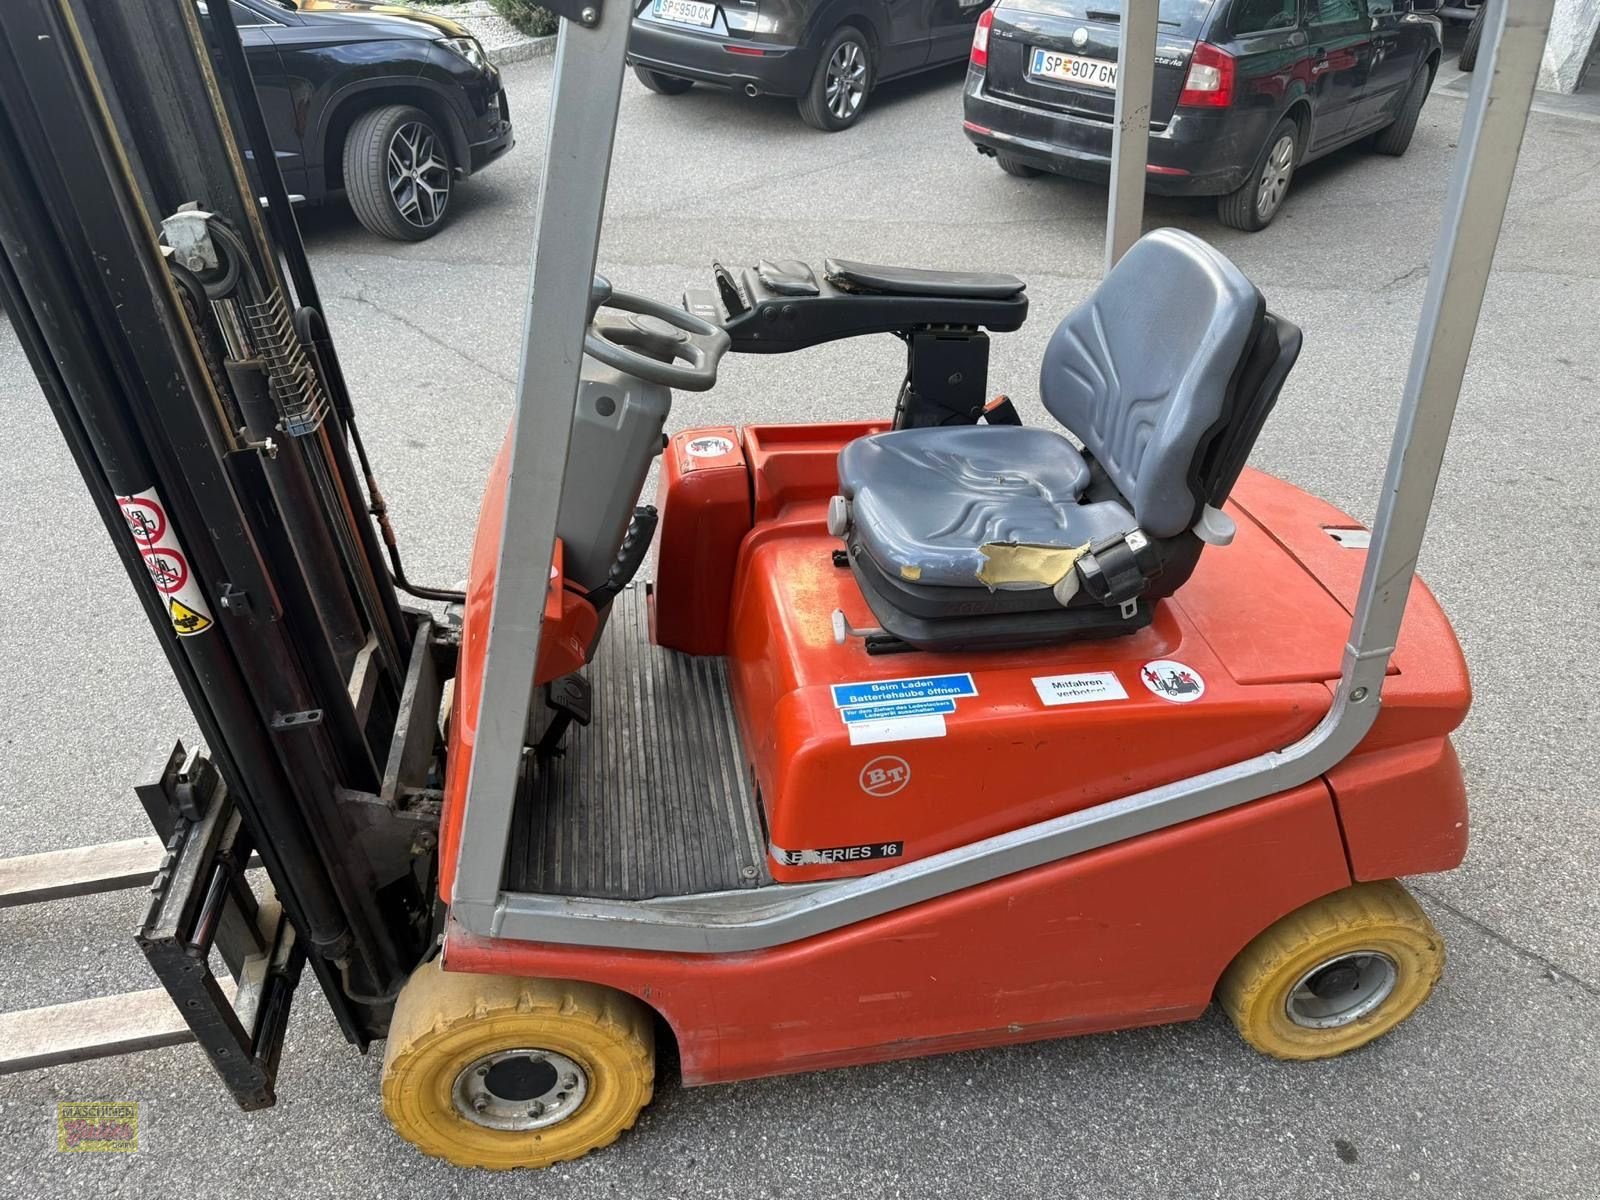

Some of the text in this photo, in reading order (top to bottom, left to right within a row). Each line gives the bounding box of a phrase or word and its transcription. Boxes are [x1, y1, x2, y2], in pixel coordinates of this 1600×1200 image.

[679, 3, 697, 18] 950
[698, 7, 711, 21] CK
[1154, 57, 1183, 67] ctavia
[1045, 55, 1117, 84] SP 907 GN
[871, 680, 934, 692] Beim Laden
[1051, 679, 1103, 689] Mitfahren
[849, 686, 961, 703] Batteriehaube öffnen
[880, 844, 897, 856] 16
